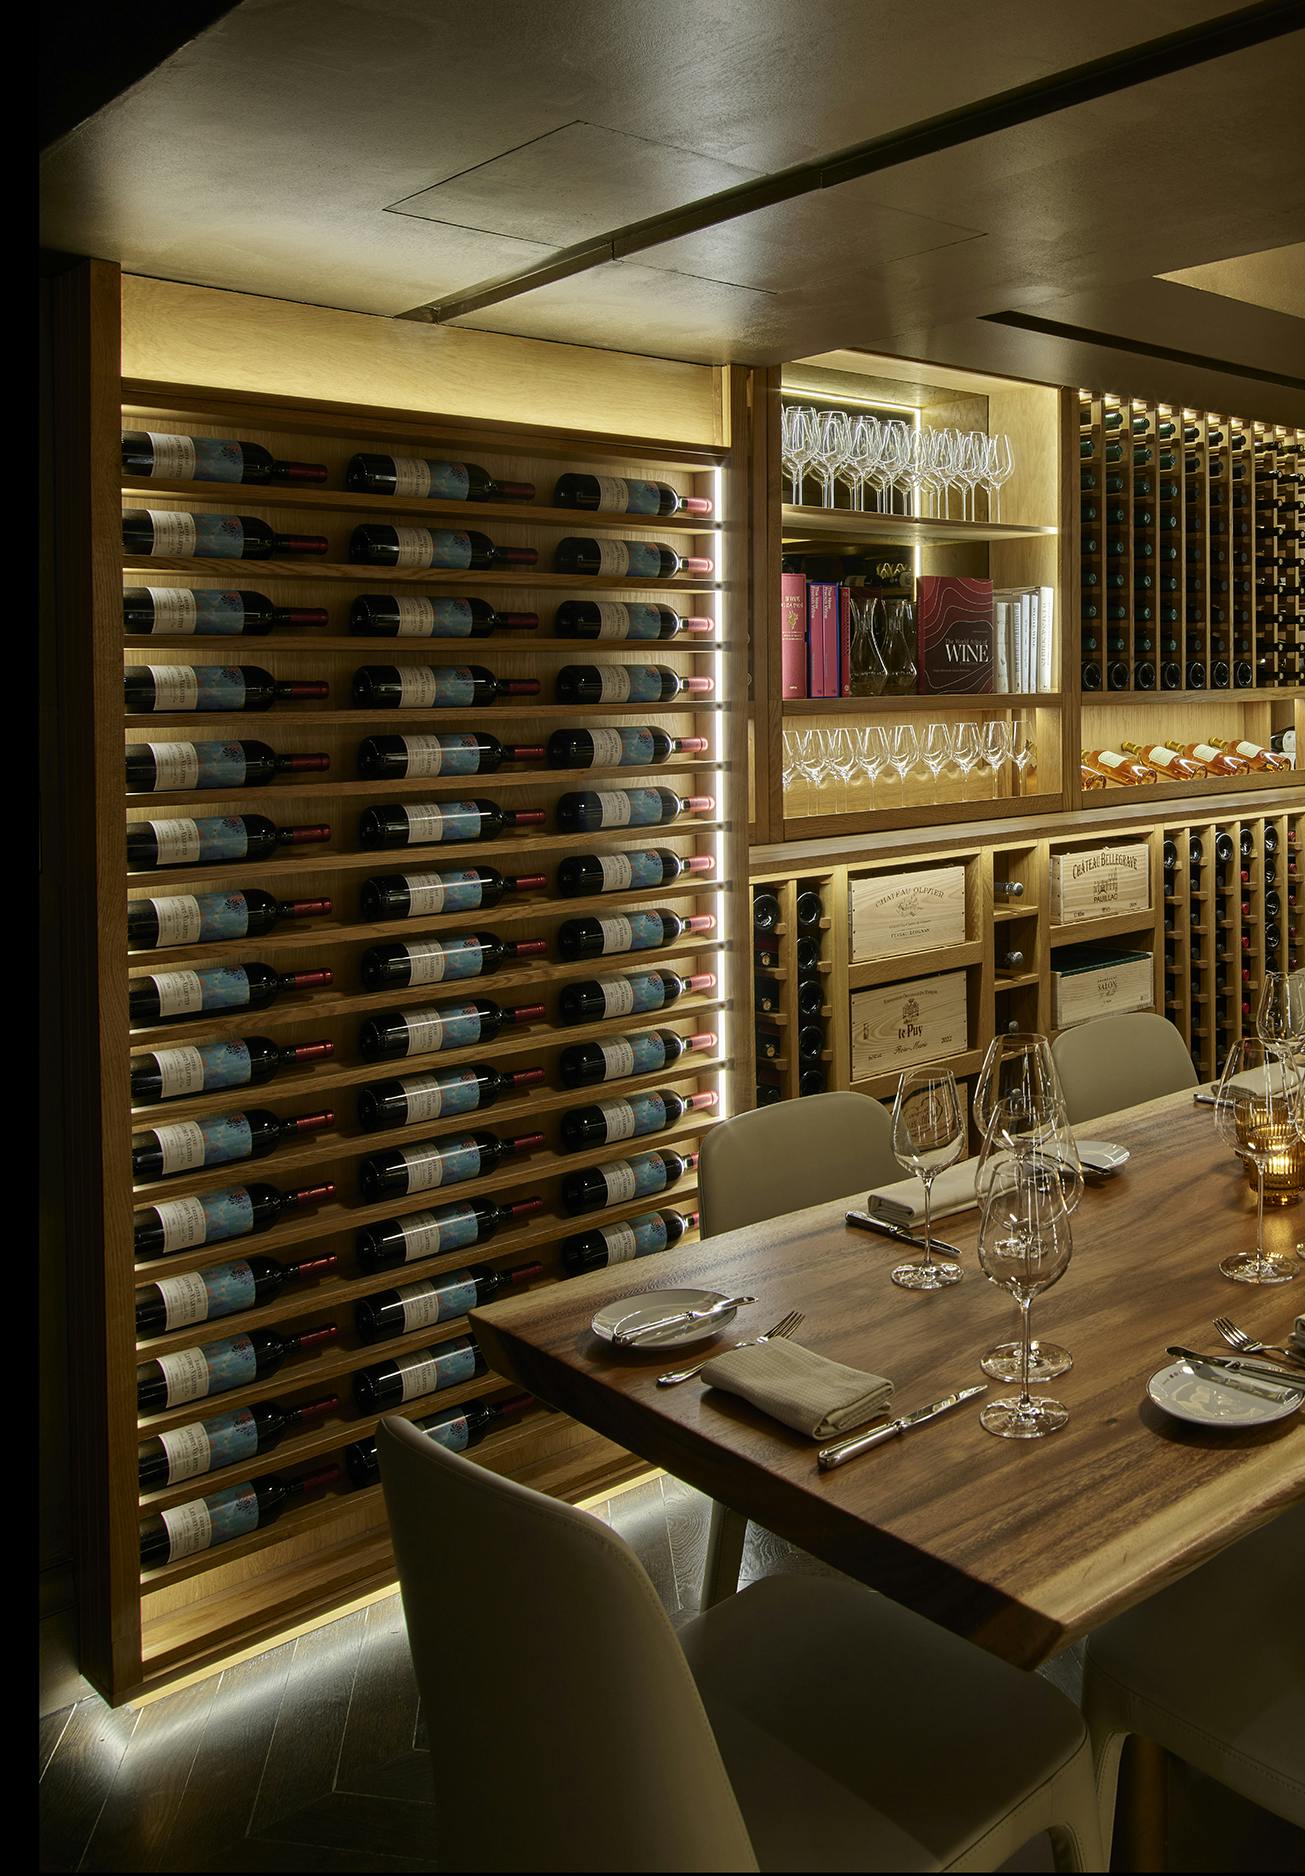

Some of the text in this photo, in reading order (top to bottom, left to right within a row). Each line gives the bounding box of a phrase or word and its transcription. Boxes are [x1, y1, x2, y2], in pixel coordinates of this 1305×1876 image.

[945, 644, 989, 662] WINE
[1100, 852, 1138, 870] BELLEGRAVE
[1093, 894, 1118, 904] PAUILLAC
